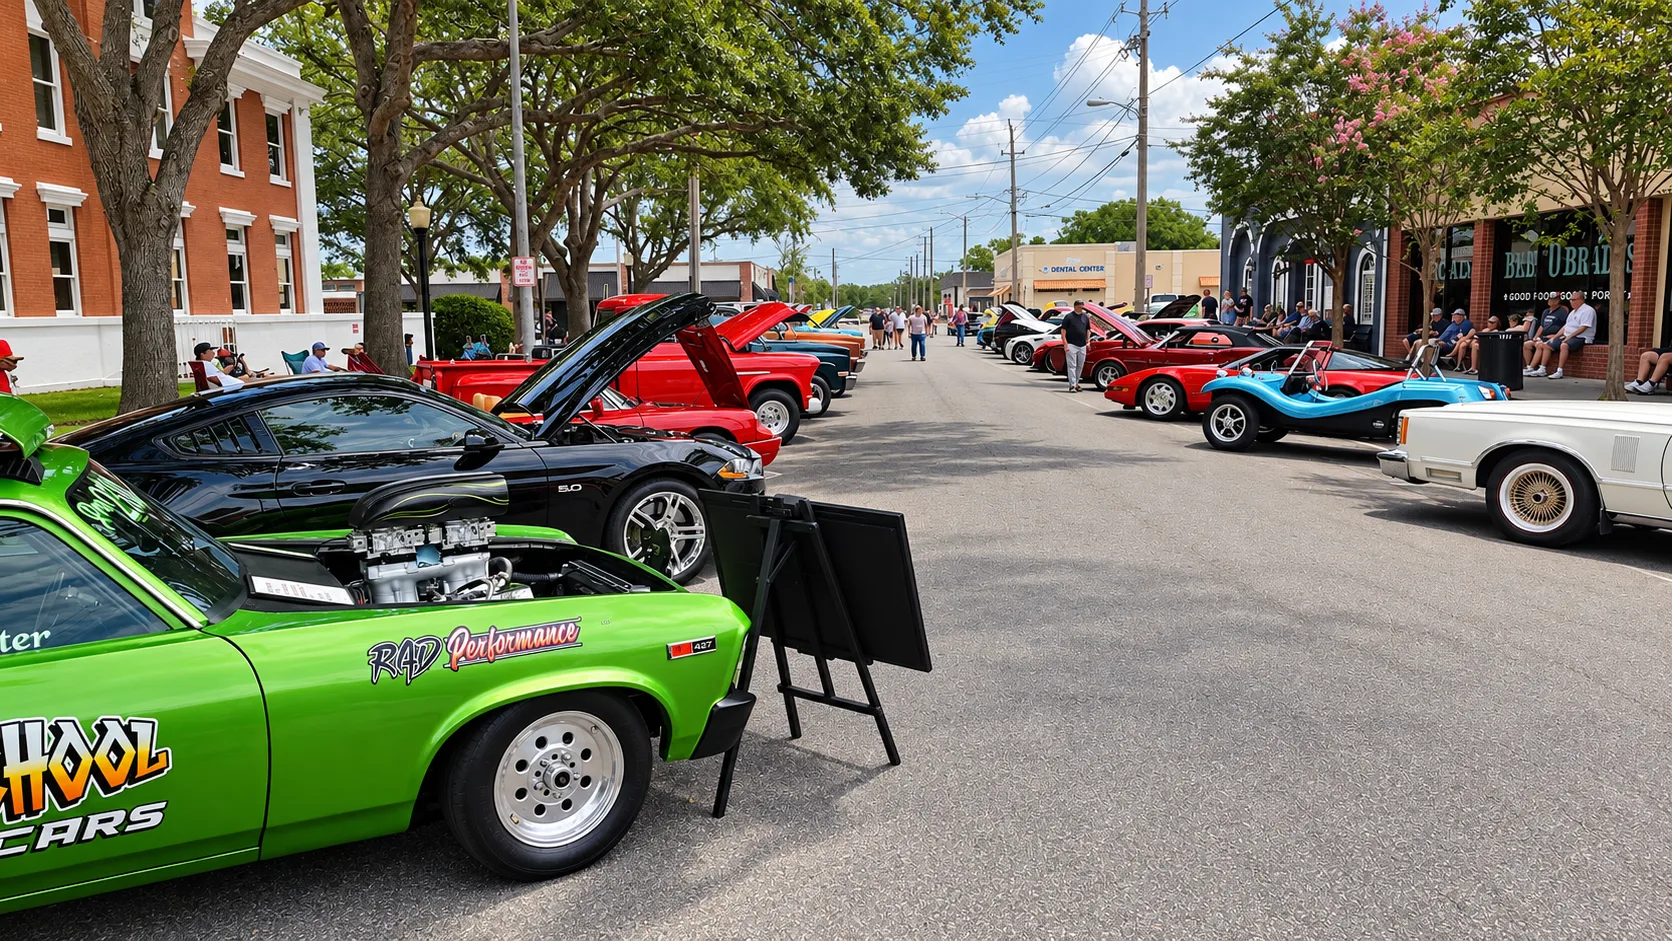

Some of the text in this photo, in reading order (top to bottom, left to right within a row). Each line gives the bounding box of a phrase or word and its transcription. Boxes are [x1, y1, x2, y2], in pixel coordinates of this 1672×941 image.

[1079, 265, 1105, 273] CENTER
[1509, 292, 1531, 301] GOOD
[1533, 291, 1556, 301] FOO
[557, 483, 582, 493] 5.0
[368, 620, 582, 685] RAD Performance
[0, 716, 171, 823] HOOL
[0, 801, 168, 859] CARS
